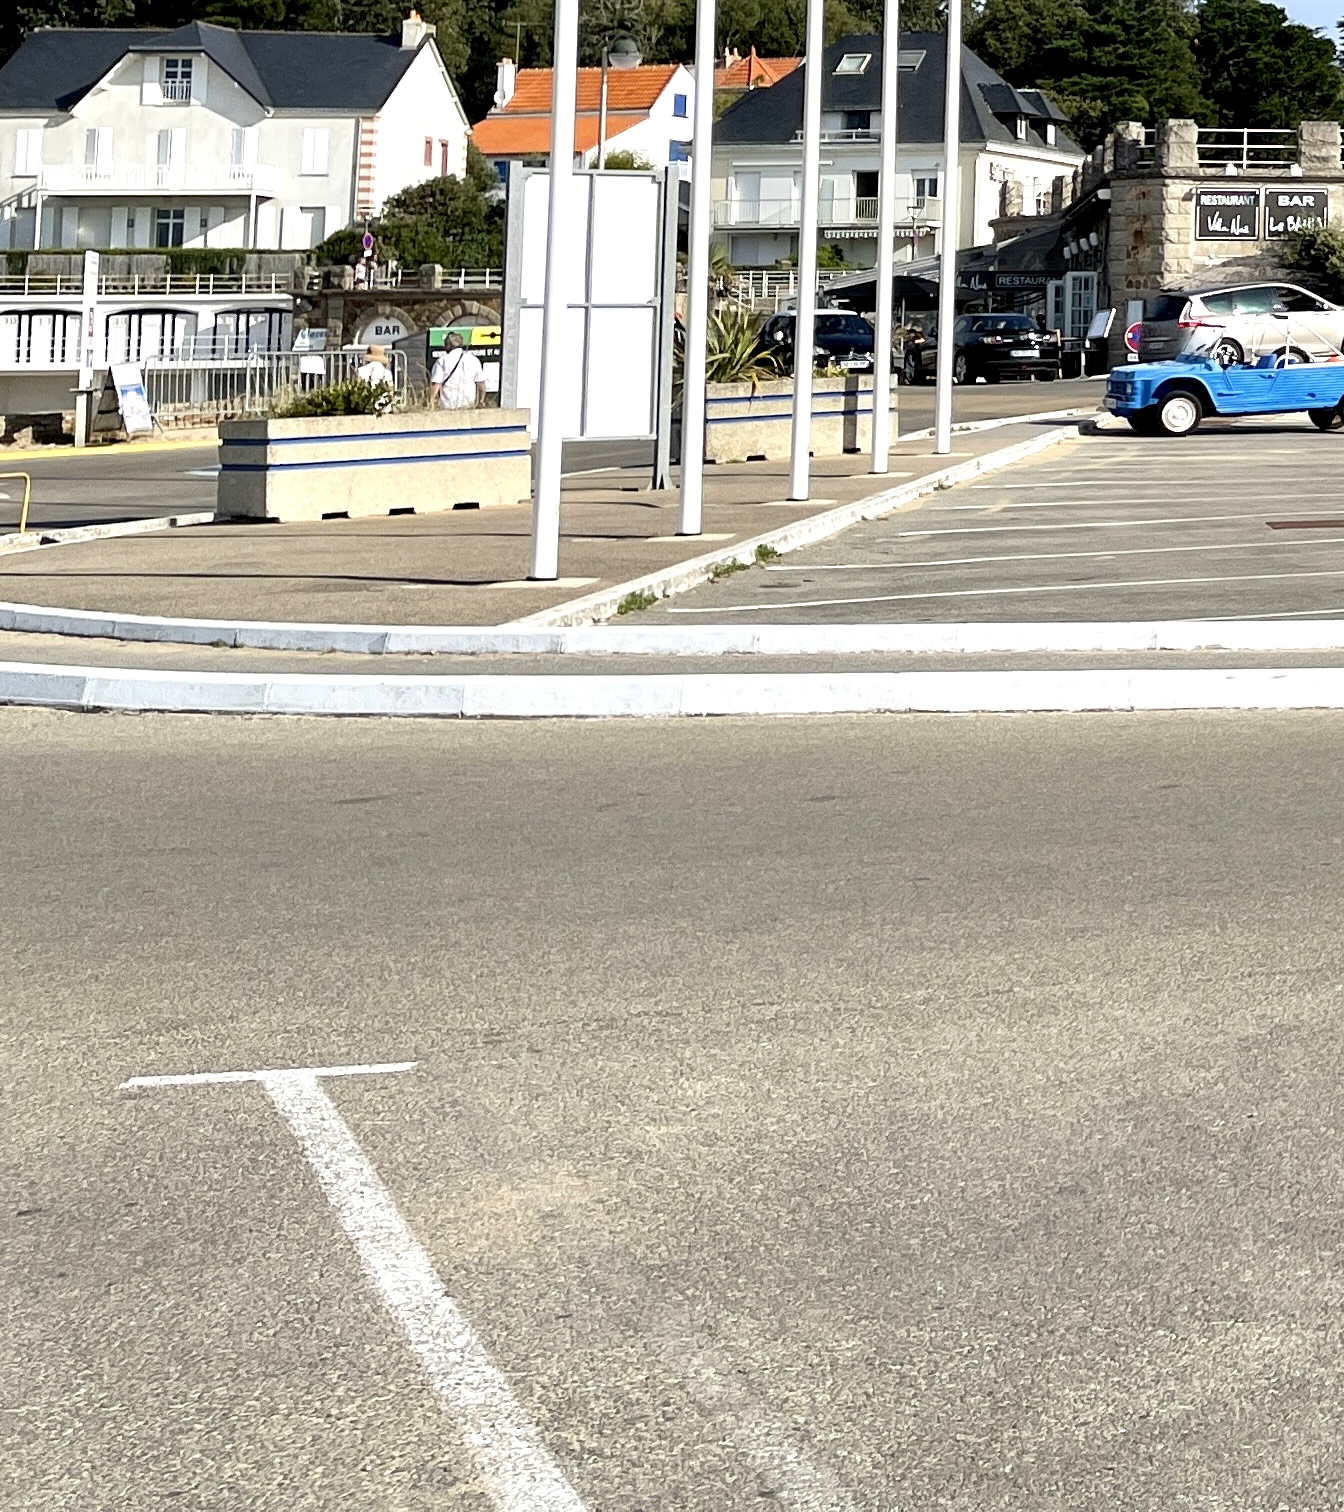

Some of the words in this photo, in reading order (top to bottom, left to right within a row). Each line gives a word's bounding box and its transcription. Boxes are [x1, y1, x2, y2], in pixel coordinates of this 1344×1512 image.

[1200, 194, 1255, 206] RESTAURANT
[1277, 195, 1315, 206] BAR
[374, 325, 400, 336] BAR
